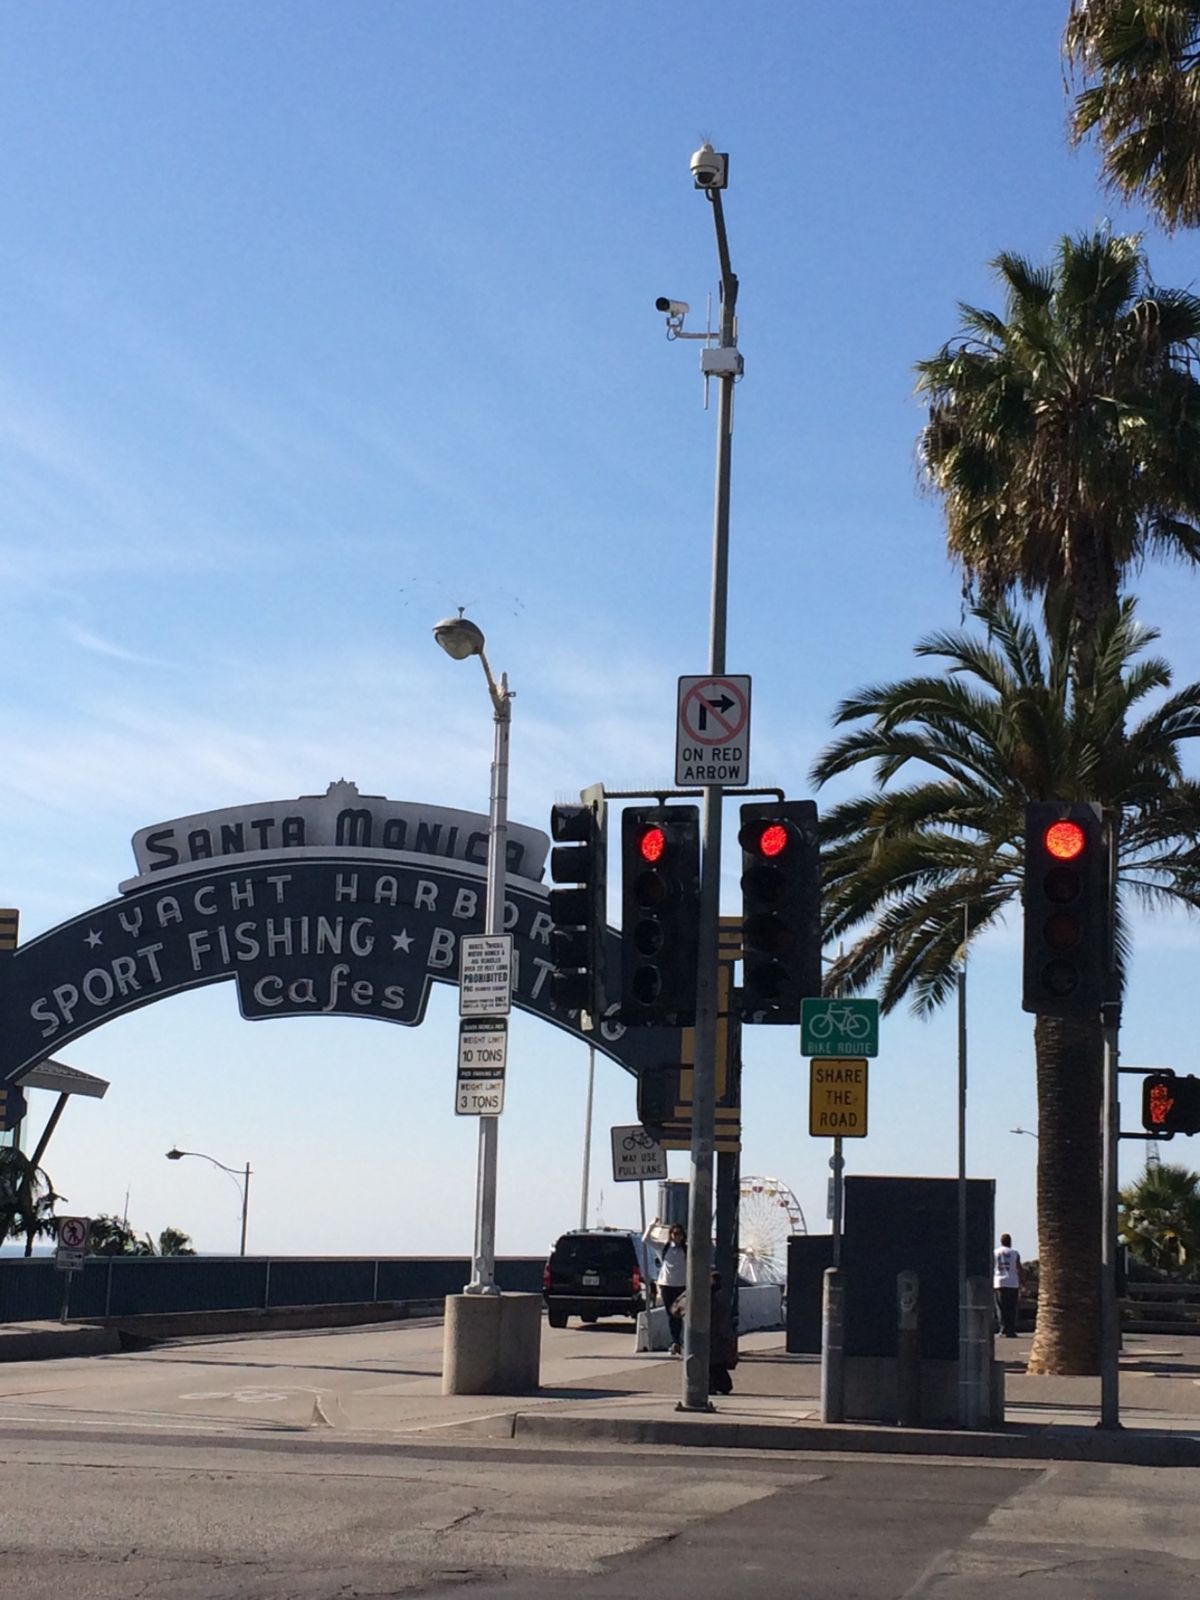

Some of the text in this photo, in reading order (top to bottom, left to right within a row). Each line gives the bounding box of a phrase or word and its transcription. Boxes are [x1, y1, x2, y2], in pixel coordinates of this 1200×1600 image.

[682, 747, 743, 761] ON RED
[684, 765, 740, 779] ARROW
[146, 808, 525, 873] SANTA MONICA
[119, 874, 292, 939] YACHT
[30, 916, 375, 1038] SPORT FISHING
[808, 1042, 873, 1054] BIKE ROUTE
[463, 1049, 503, 1062] 10 TONS
[816, 1069, 863, 1083] SHARE
[461, 1096, 499, 1108] 3 TONS
[826, 1090, 852, 1105] THE
[820, 1112, 858, 1127] ROAD
[622, 1152, 657, 1162] MAY USE
[618, 1164, 663, 1176] FULL LANE
